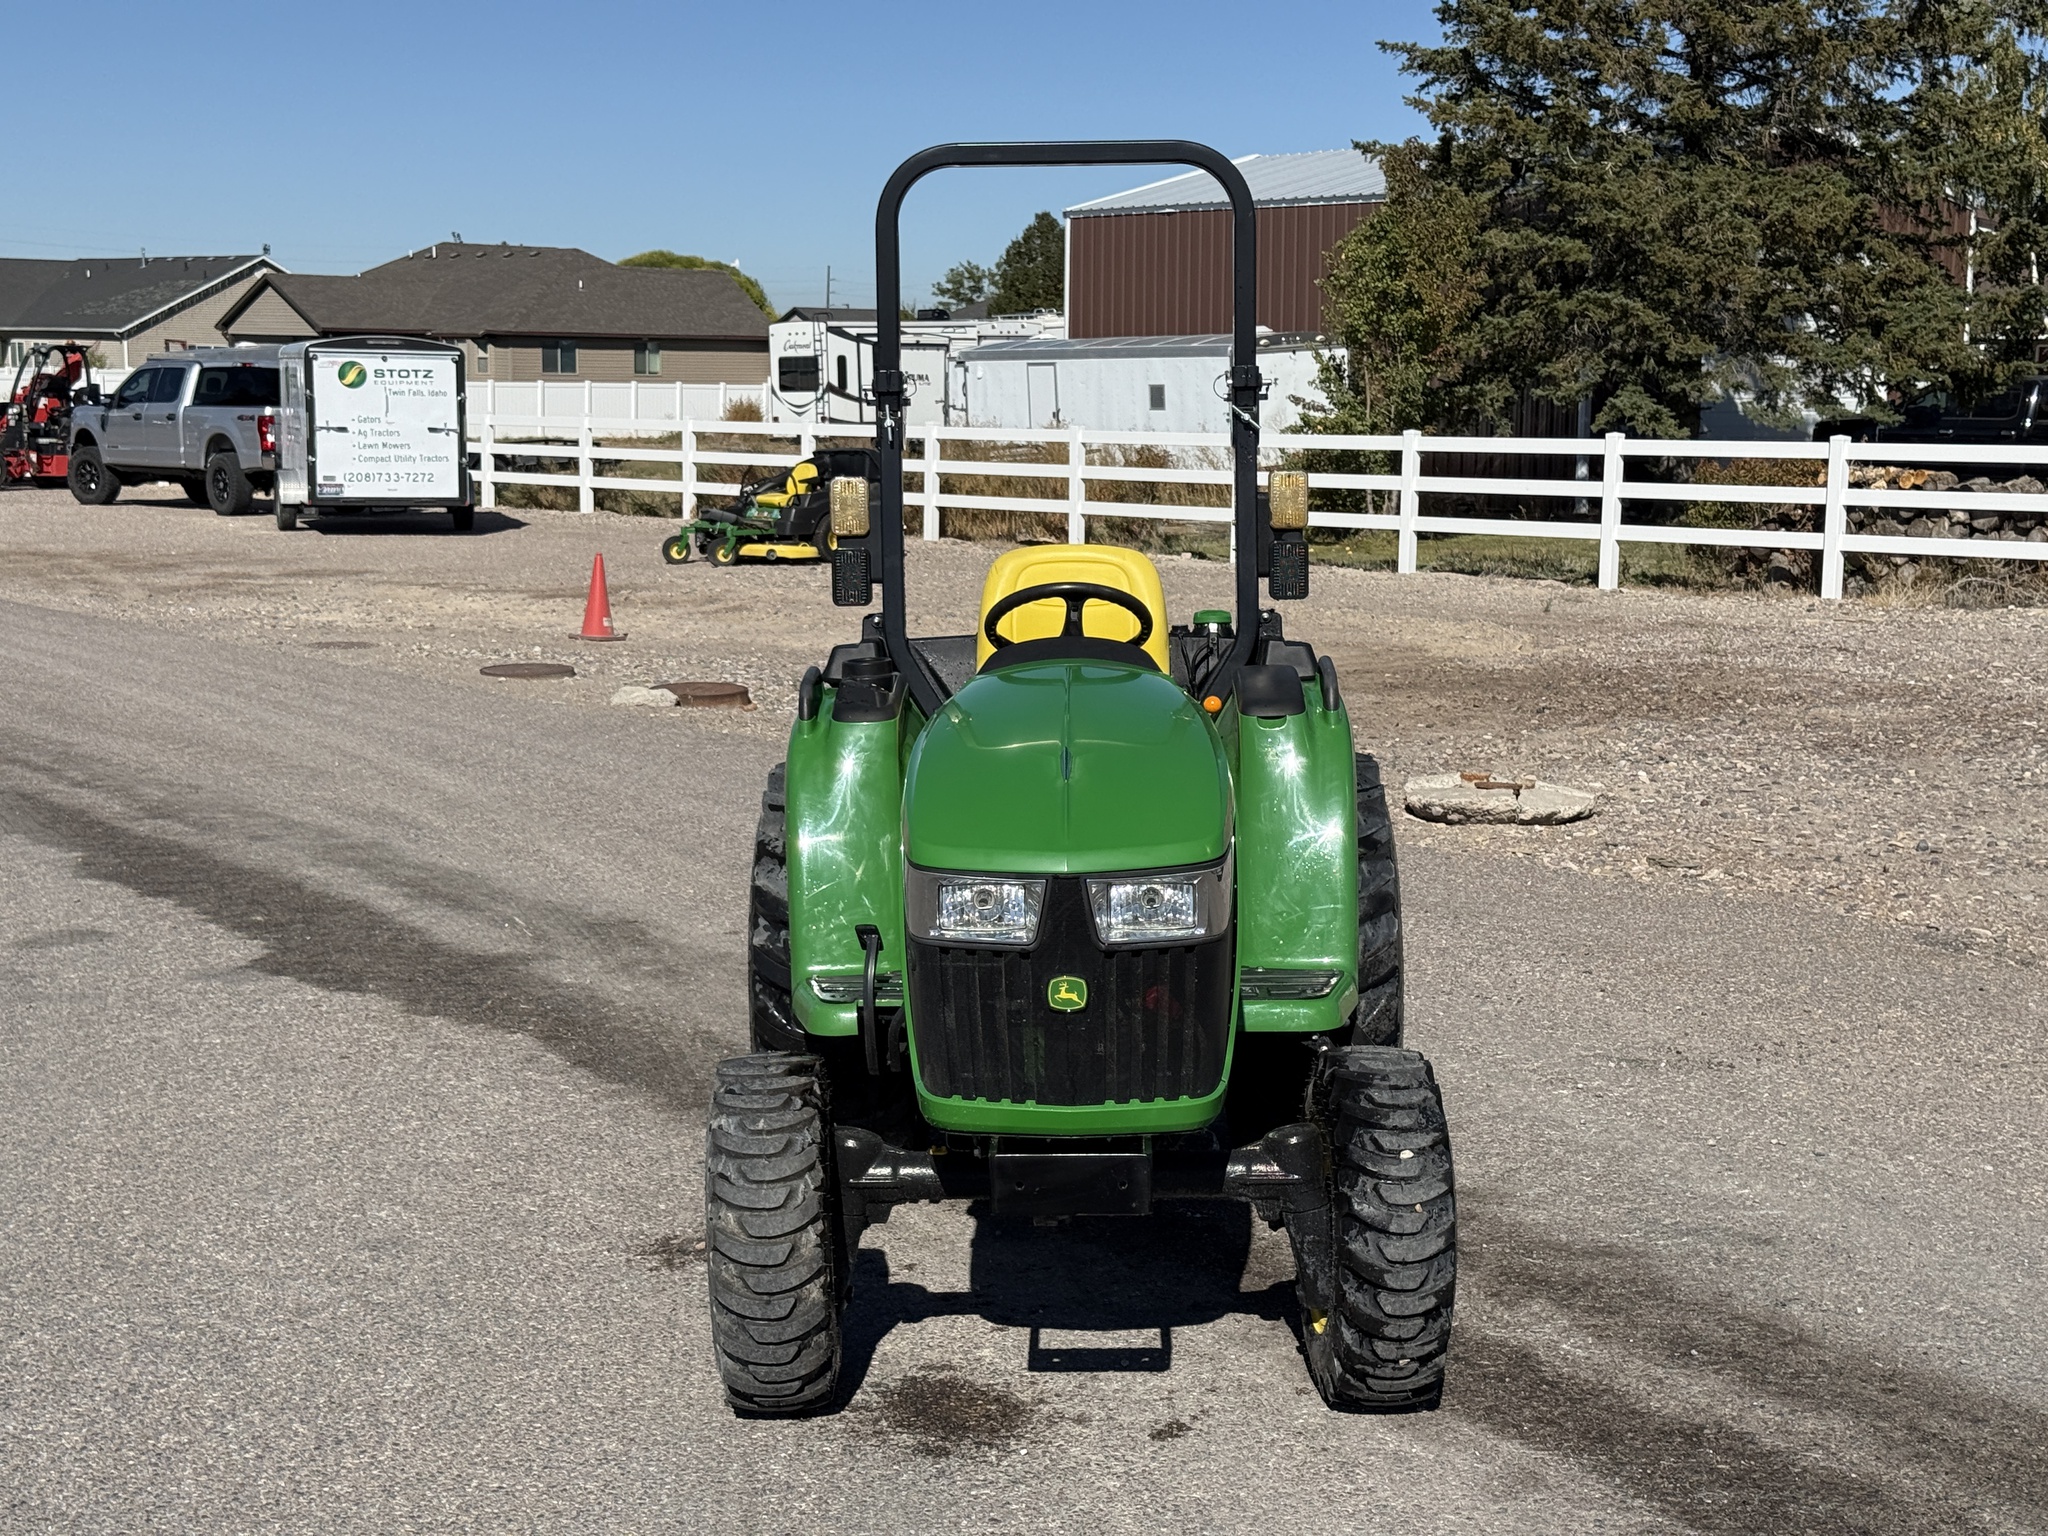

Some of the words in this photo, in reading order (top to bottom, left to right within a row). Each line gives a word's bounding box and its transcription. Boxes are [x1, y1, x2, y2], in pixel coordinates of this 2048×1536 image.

[374, 369, 433, 379] STOTZ
[388, 389, 406, 397] Twin
[428, 389, 448, 397] Idaho
[357, 416, 382, 424] Gators
[357, 430, 368, 438] Ag
[370, 429, 401, 437] Tractors
[357, 442, 379, 450] Lawn
[382, 442, 411, 450] Mowers
[358, 455, 391, 464] Compact
[394, 455, 417, 464] Utility
[419, 455, 449, 463] Tractors
[343, 472, 435, 483] (208)733-7272
